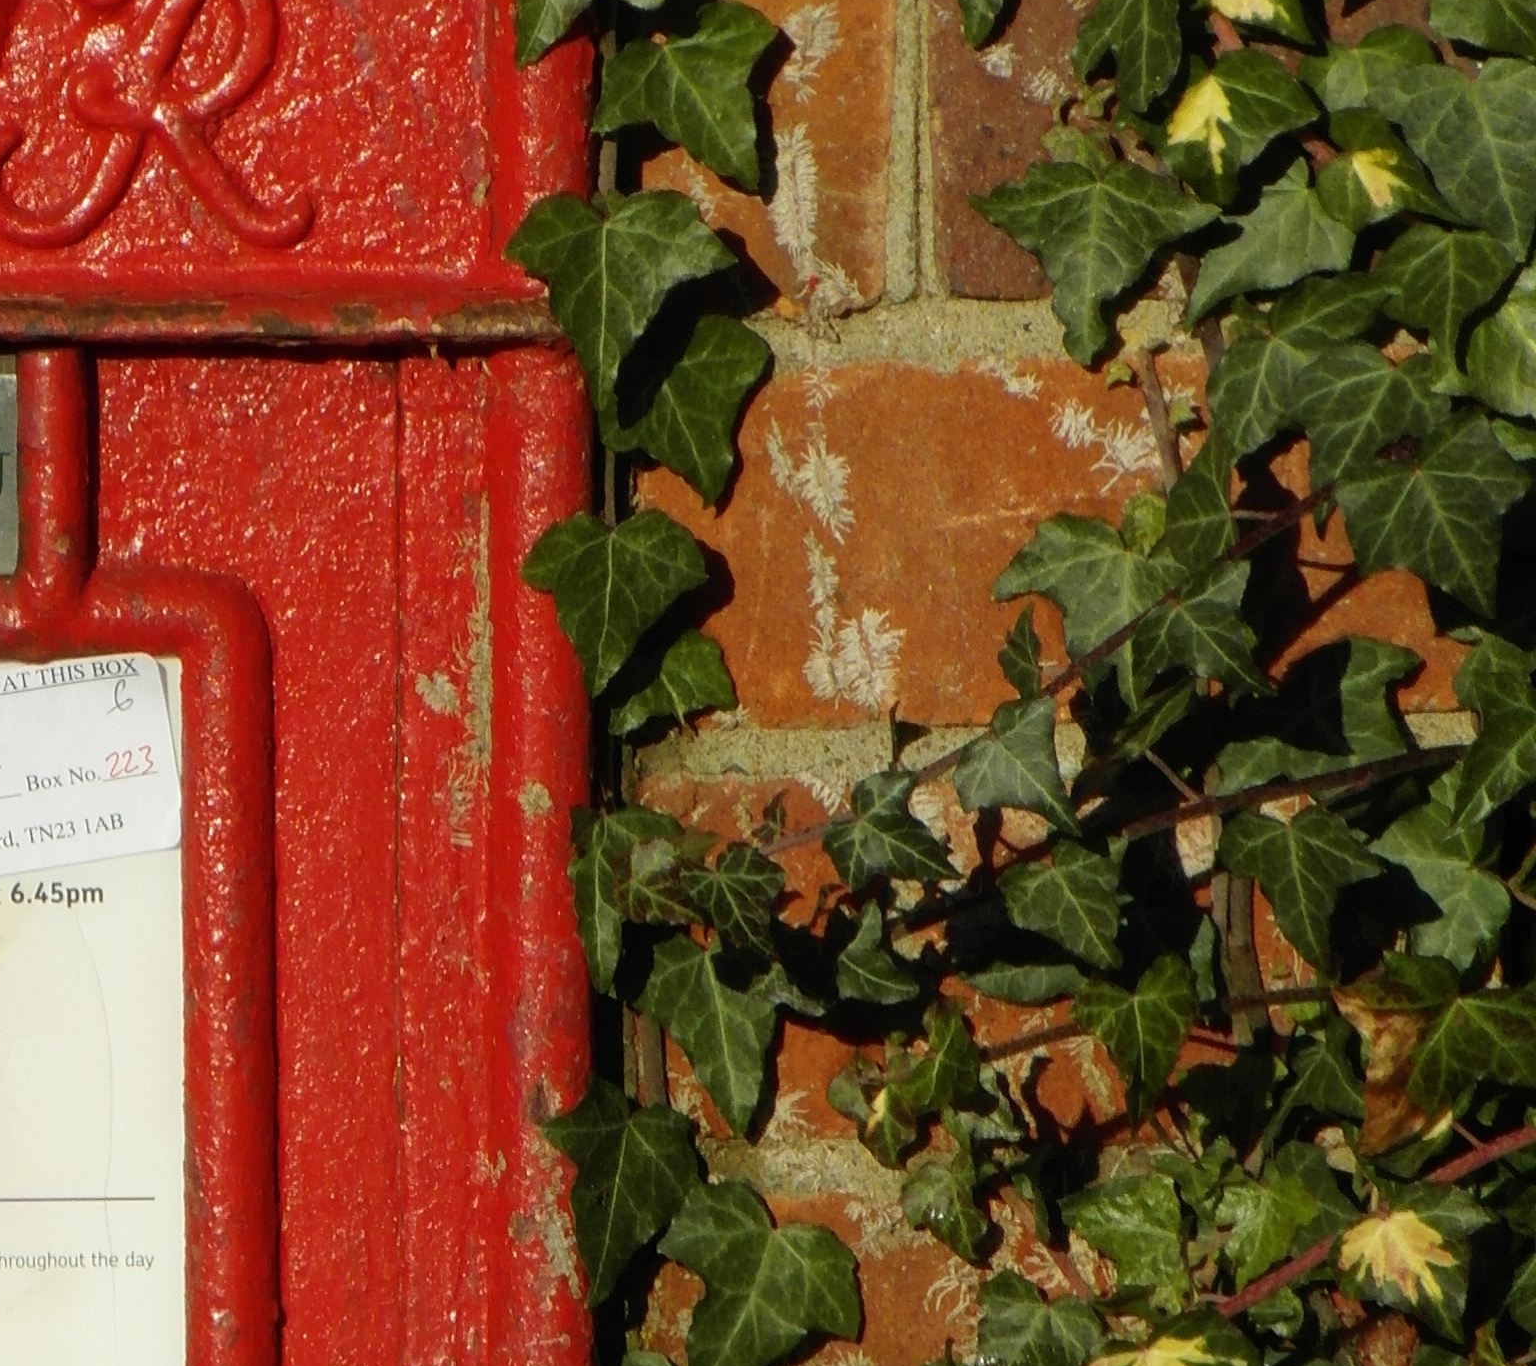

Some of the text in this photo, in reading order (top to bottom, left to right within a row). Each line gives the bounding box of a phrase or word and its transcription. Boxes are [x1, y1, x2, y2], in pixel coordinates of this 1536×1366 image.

[2, 671, 31, 693] AT
[34, 663, 85, 686] THIS
[91, 658, 139, 678] BOX
[25, 775, 64, 793] Box
[68, 766, 101, 786] No.
[104, 745, 156, 779] 223
[24, 820, 77, 845] TN23
[85, 812, 124, 834] 1AB
[10, 881, 104, 909] 6.45pm
[91, 1251, 119, 1269] the
[125, 1250, 155, 1271] day
